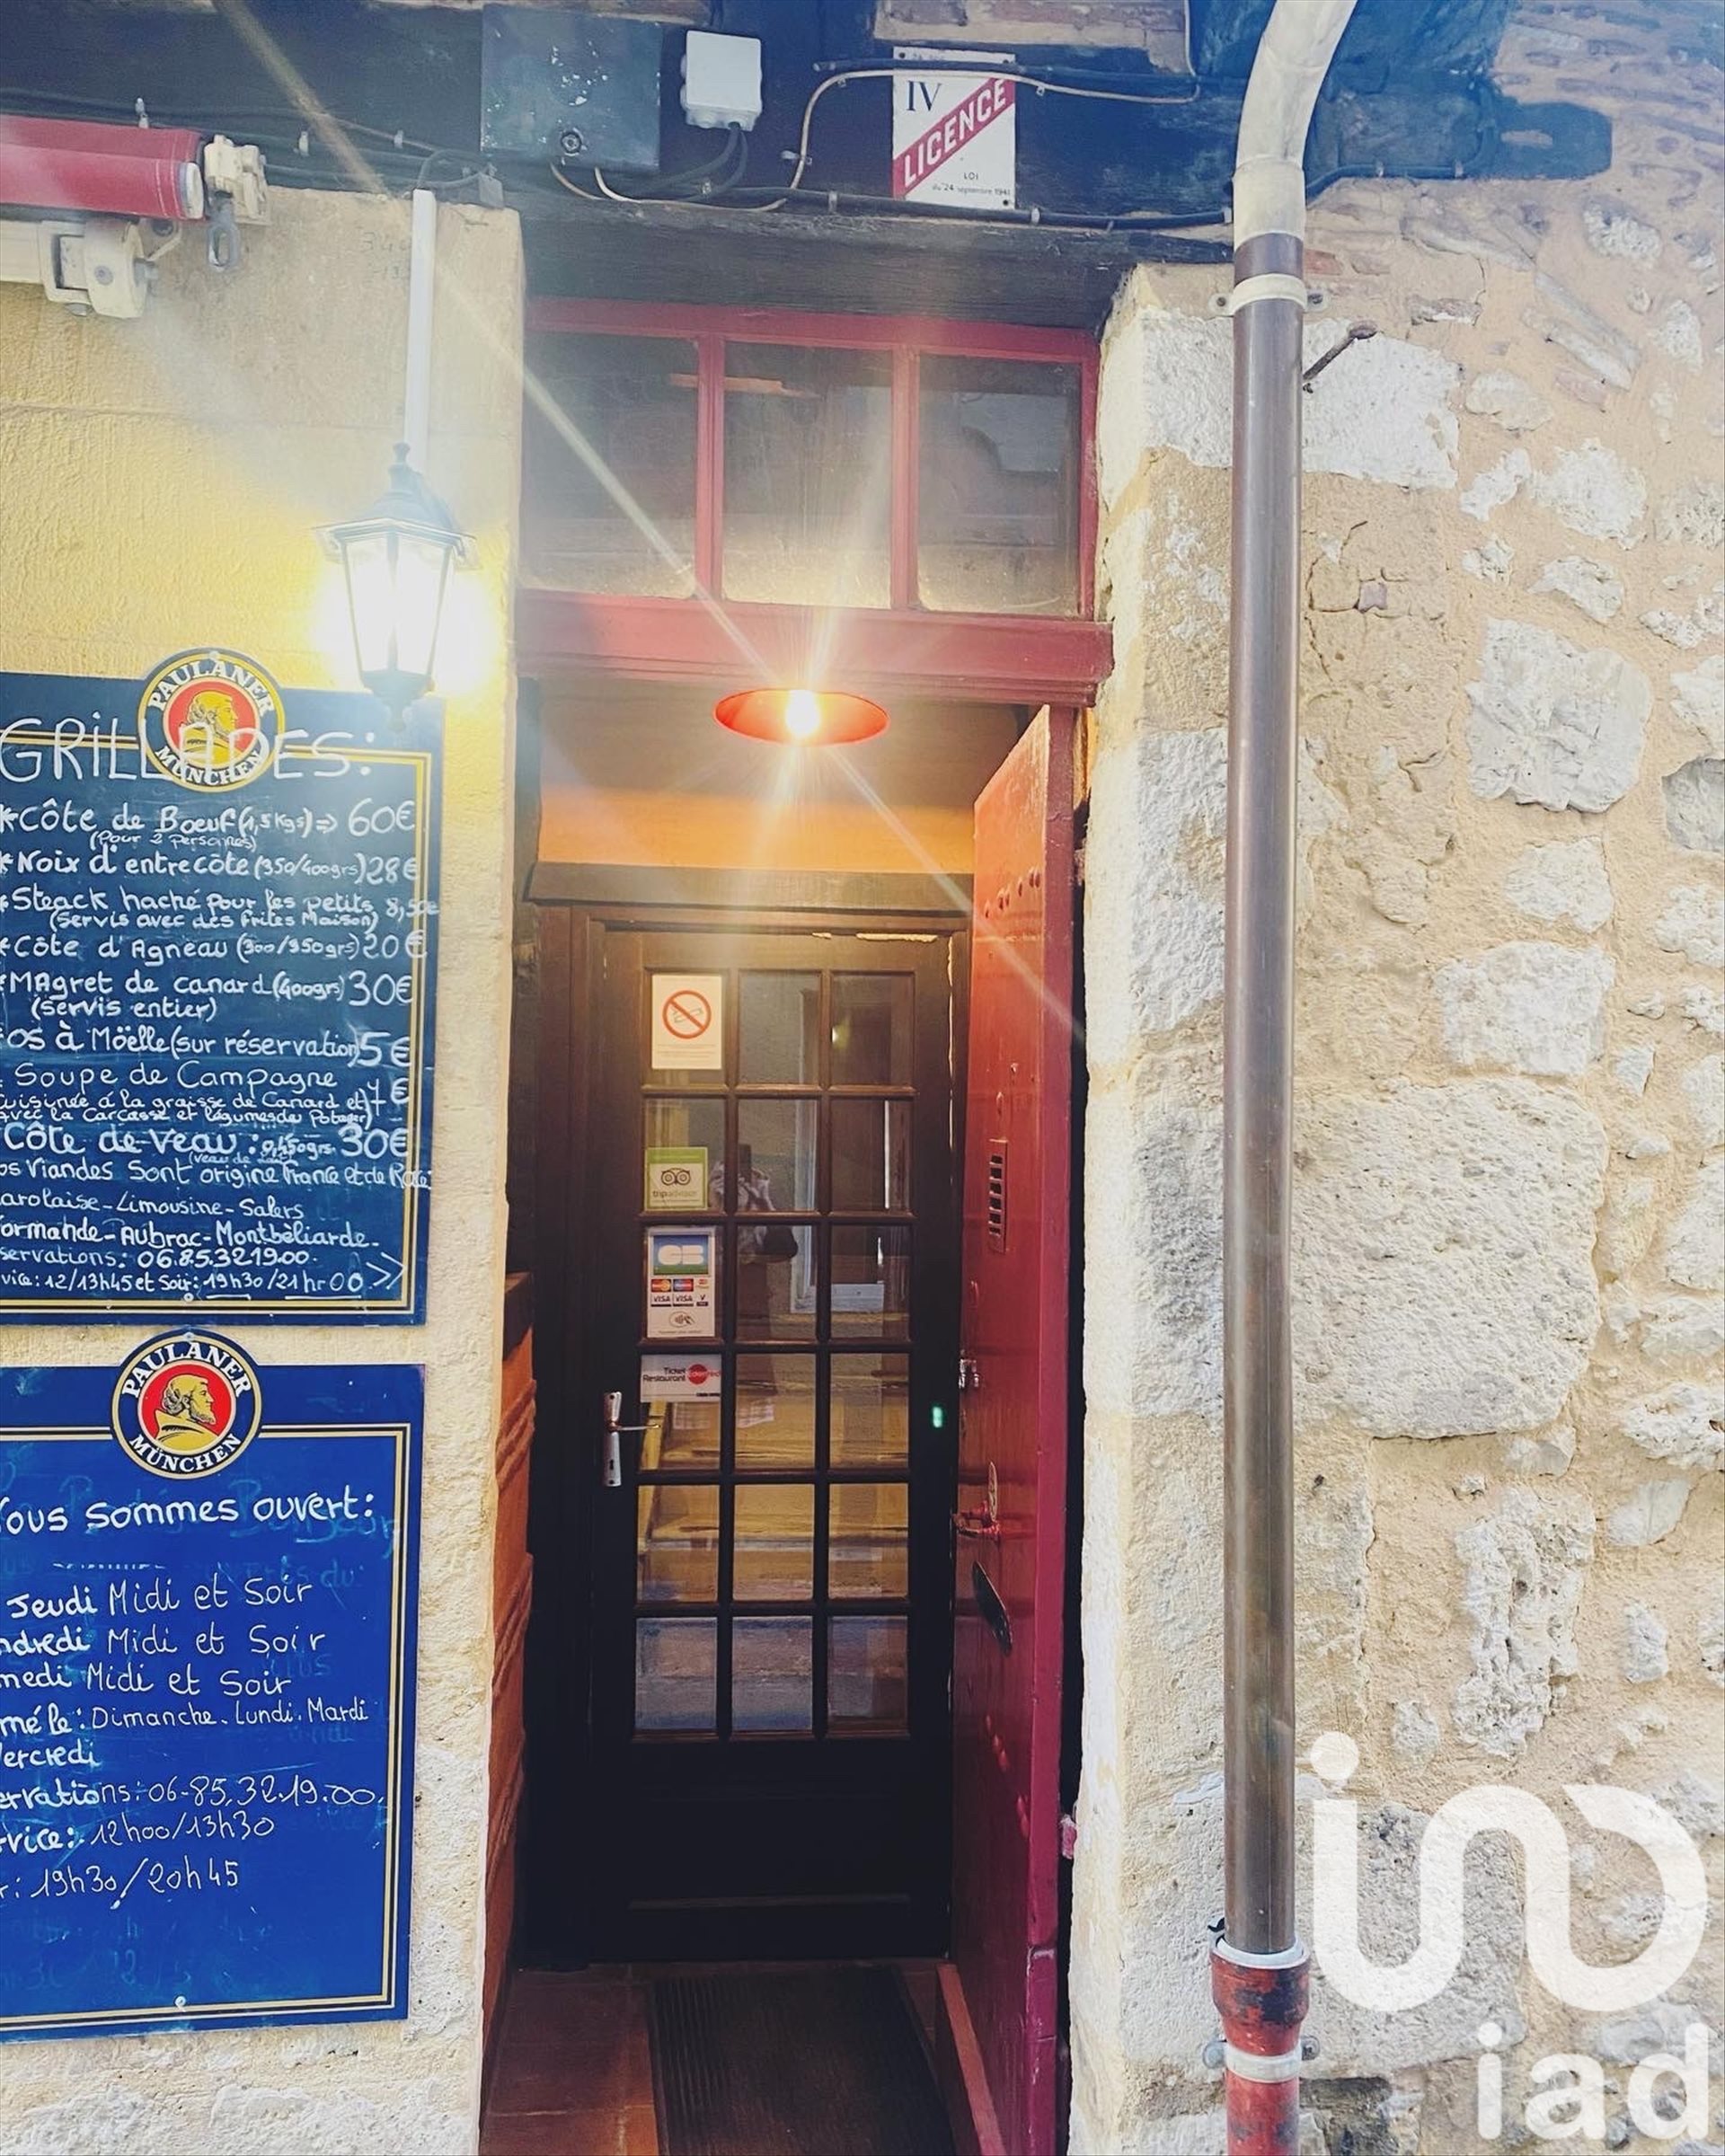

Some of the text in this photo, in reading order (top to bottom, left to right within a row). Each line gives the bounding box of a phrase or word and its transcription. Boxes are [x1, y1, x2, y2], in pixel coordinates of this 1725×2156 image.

[907, 79, 942, 111] IV
[904, 78, 1005, 188] LICENCE
[963, 172, 978, 181] LOI
[148, 660, 274, 717] PAULANER
[112, 802, 146, 831] de
[348, 798, 416, 837] 60€
[150, 833, 163, 844] 2
[18, 851, 80, 873] Noix
[119, 885, 201, 912] haché
[264, 888, 296, 910] les
[137, 915, 185, 928] avec
[191, 911, 234, 929] des
[13, 933, 78, 959] Côte
[131, 939, 228, 968] Agneau
[125, 969, 159, 994] de
[348, 970, 414, 1007] 30€
[134, 996, 217, 1022] entier)
[55, 1020, 85, 1051] à
[14, 1062, 118, 1094] Soupe
[129, 1062, 168, 1085] de
[177, 1060, 338, 1099] Campagne
[50, 1108, 74, 1121] la
[176, 1108, 198, 1121] et
[119, 1089, 146, 1108] la
[152, 1096, 226, 1116] graisse
[232, 1092, 257, 1109] de
[4, 1122, 85, 1153] Côte
[338, 1124, 408, 1159] 30€
[199, 1165, 279, 1188] origine
[239, 1195, 304, 1220] Salers
[135, 1271, 155, 1292] et
[121, 1342, 252, 1399] PAULANER
[663, 1366, 686, 1374] Ticket
[128, 1434, 241, 1473] MÜNCHEN
[108, 1577, 180, 1616] Midi
[194, 1572, 229, 1611] et
[244, 1574, 313, 1605] Soir
[107, 1623, 178, 1656] Midi
[195, 1621, 225, 1655] et
[249, 1624, 325, 1654] Soir
[86, 1662, 155, 1692] Midi
[168, 1663, 200, 1696] et
[219, 1670, 292, 1697] Soir
[307, 1696, 369, 1723] Mardi
